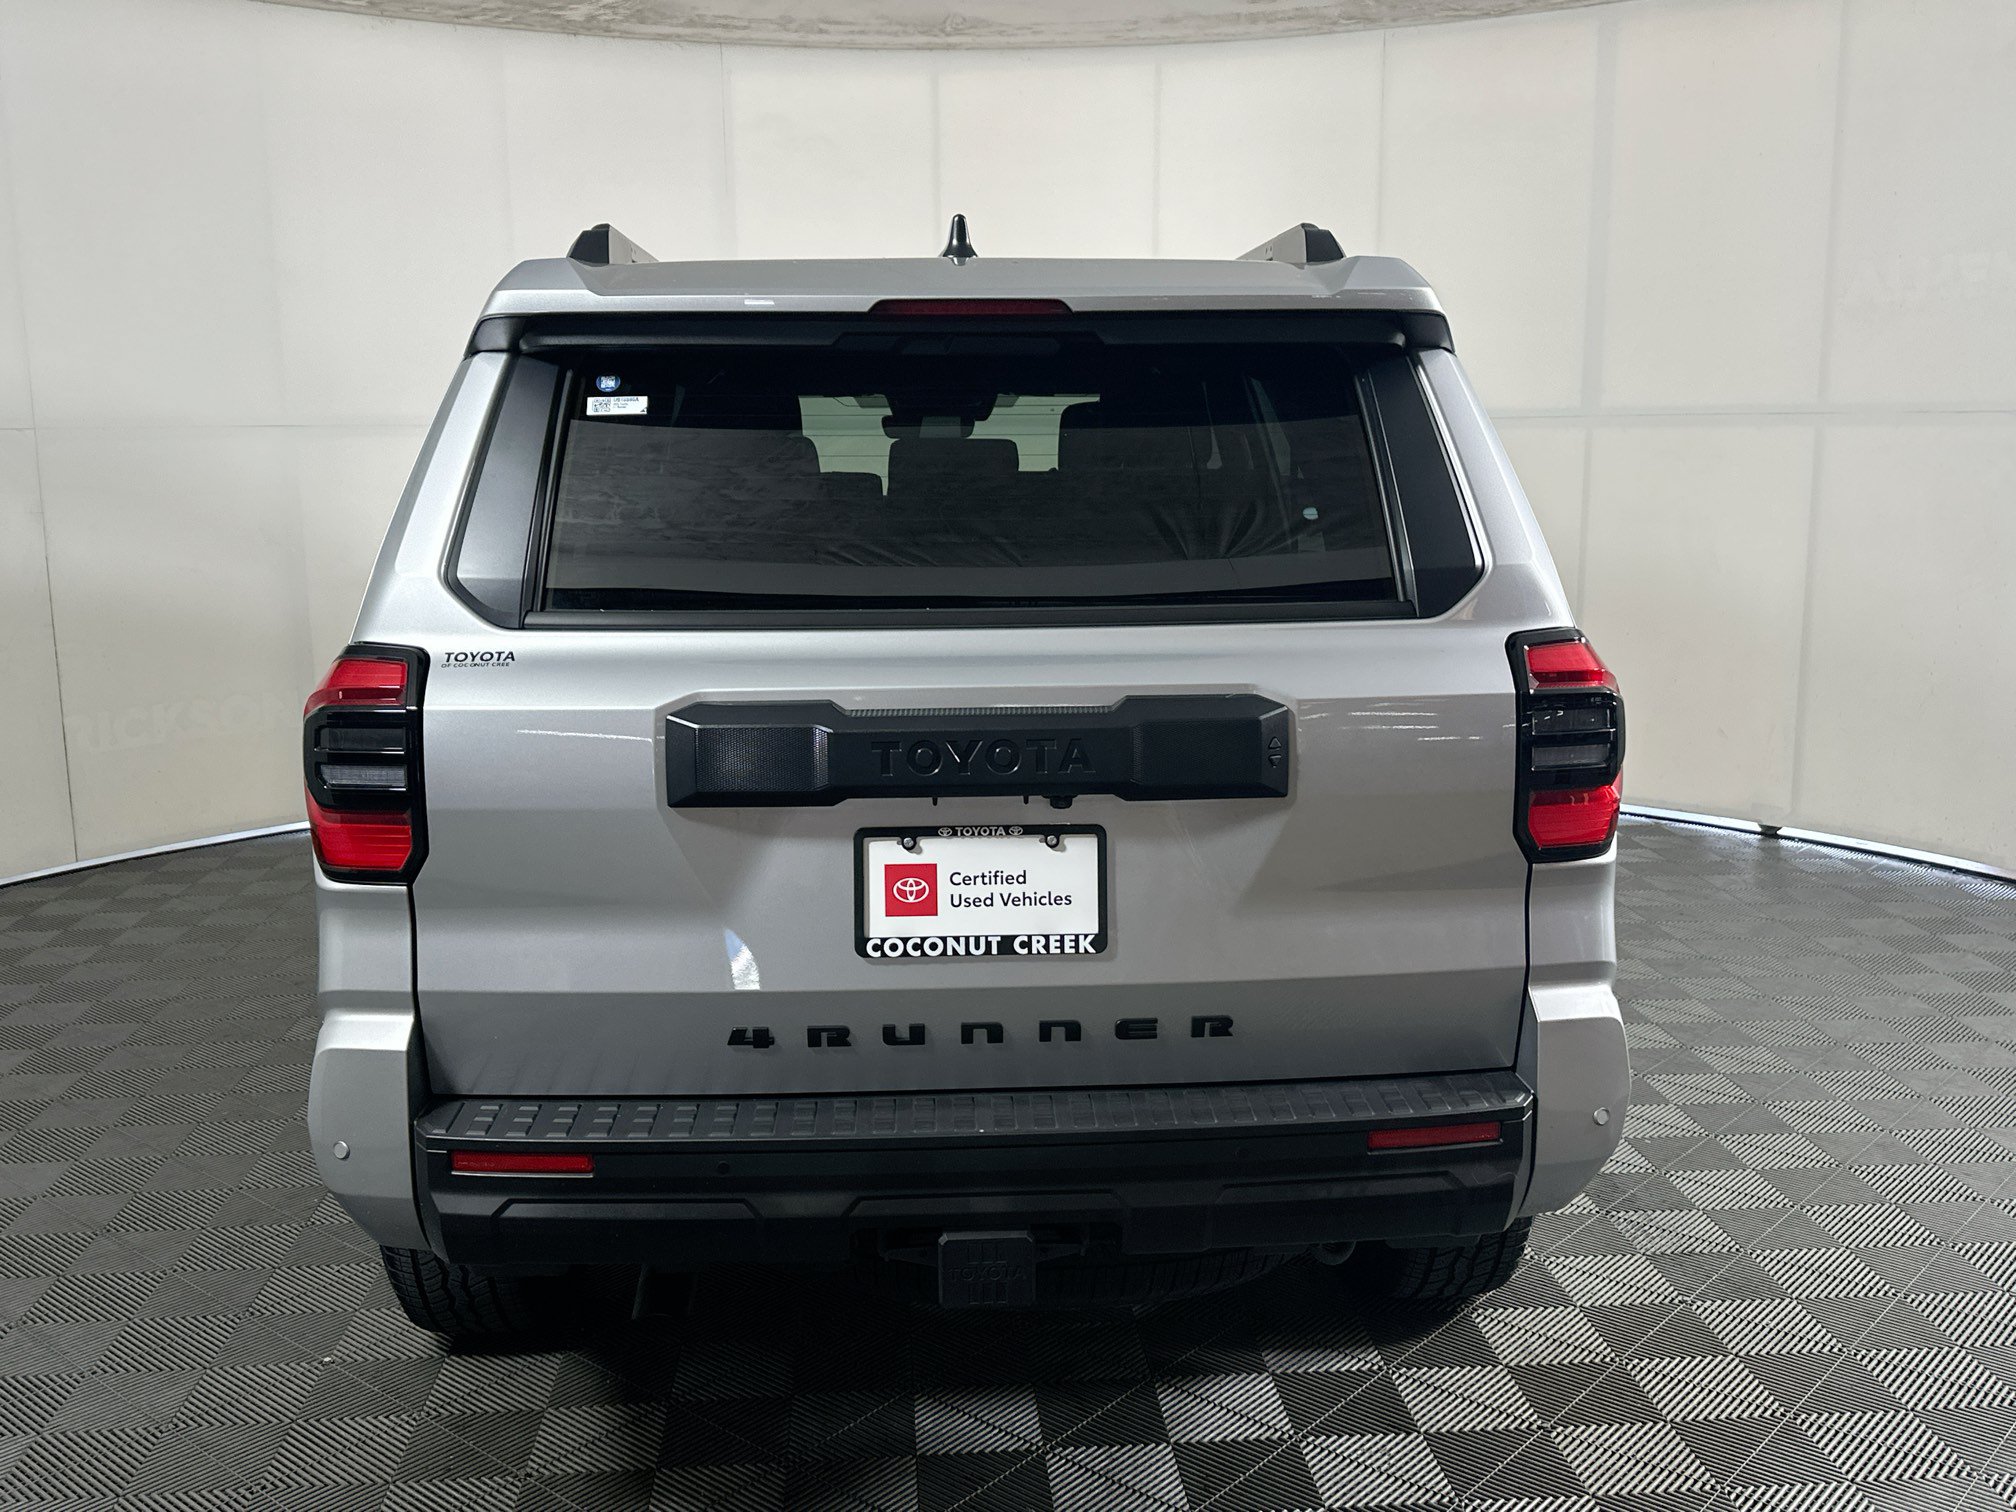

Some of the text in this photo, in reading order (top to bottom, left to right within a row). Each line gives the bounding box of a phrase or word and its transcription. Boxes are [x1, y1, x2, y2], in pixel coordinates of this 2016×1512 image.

[445, 651, 515, 662] TOYOTA
[871, 738, 1096, 777] TOYOTA
[955, 826, 1006, 837] TOYOTA
[950, 870, 1027, 886] Certified
[950, 891, 1072, 908] Used Vehicles
[866, 934, 1096, 957] COCONUT CREEK
[948, 1265, 1027, 1281] TOYOTA
